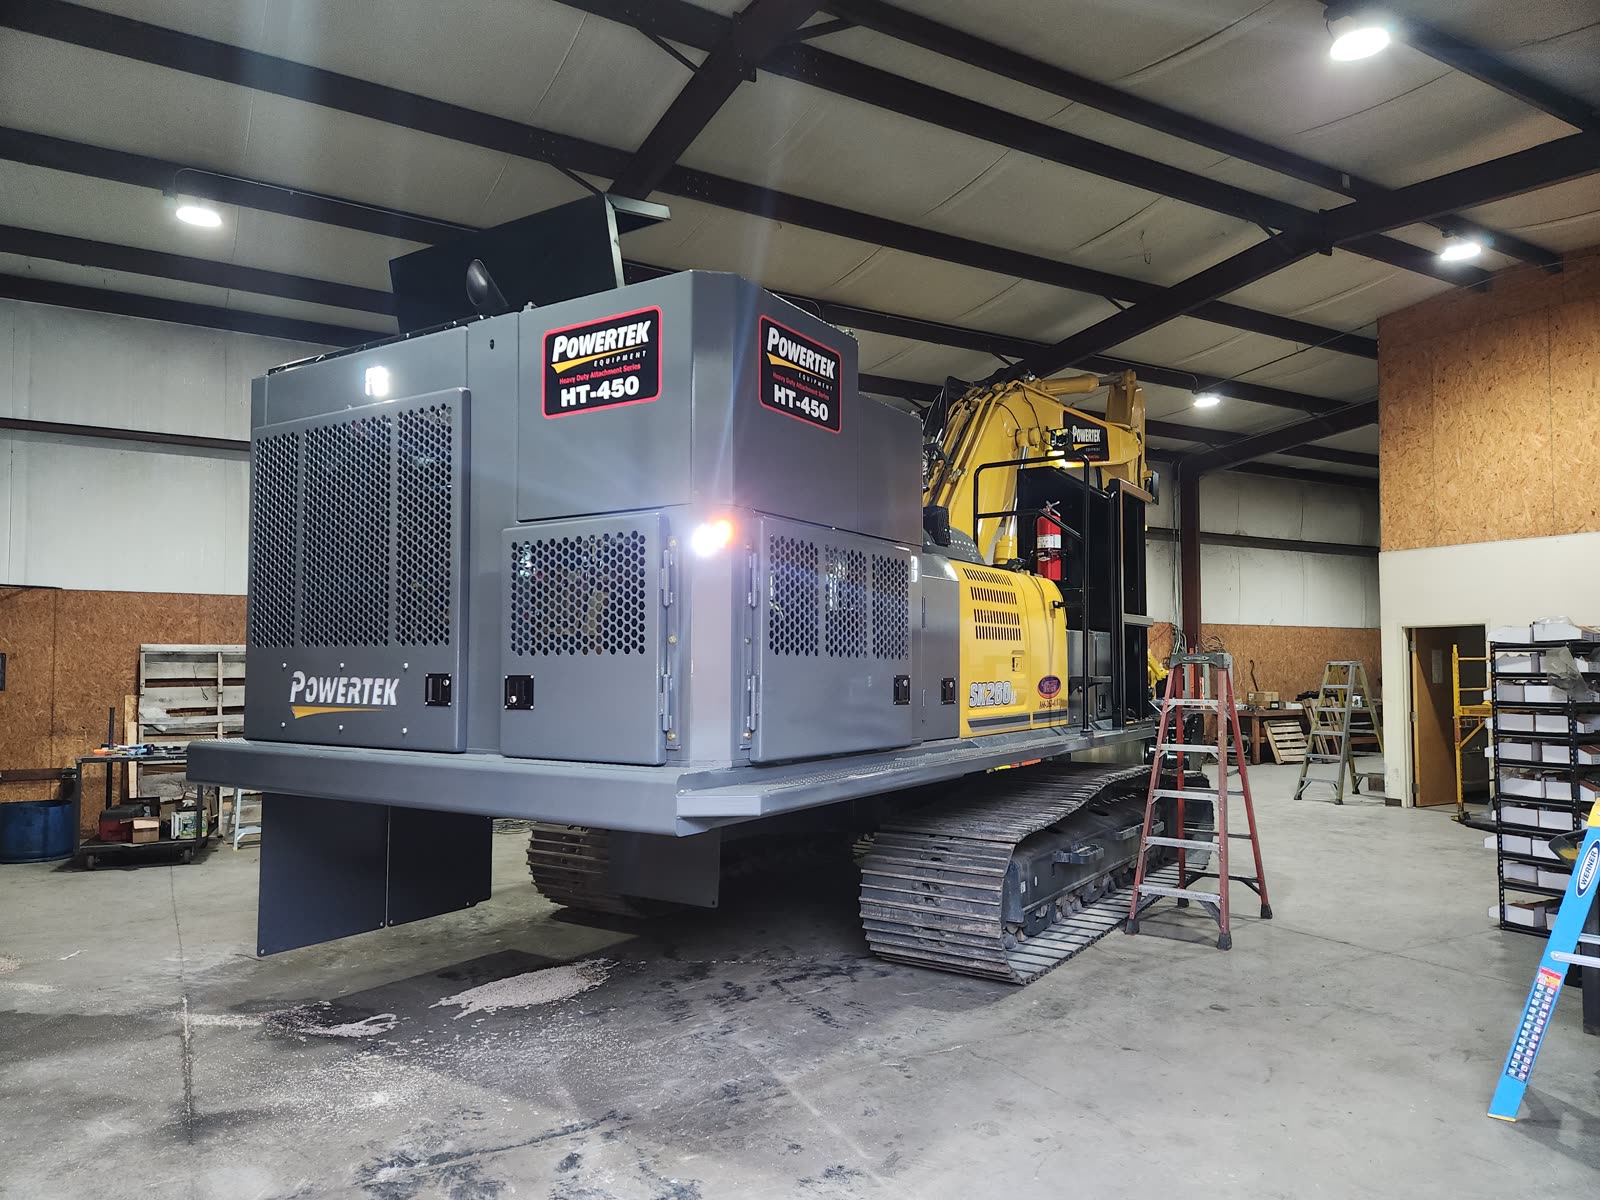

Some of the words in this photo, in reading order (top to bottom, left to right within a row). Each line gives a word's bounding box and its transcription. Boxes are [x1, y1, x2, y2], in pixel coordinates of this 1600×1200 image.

[552, 320, 651, 362] POWERTEK
[767, 326, 835, 379] POWERTEK
[559, 376, 576, 385] Heavy
[577, 373, 590, 381] Duty
[590, 366, 623, 378] Attachment
[623, 363, 641, 372] Series
[594, 350, 647, 367] EQUIPMENT
[560, 375, 640, 407] HT-450
[798, 372, 833, 391] EQUIPMENT
[774, 384, 829, 421] HT-450
[1072, 425, 1100, 442] POWERTEK
[289, 670, 400, 705] POWERTEK
[969, 680, 1012, 708] SK260
[1581, 851, 1597, 885] WERNER
